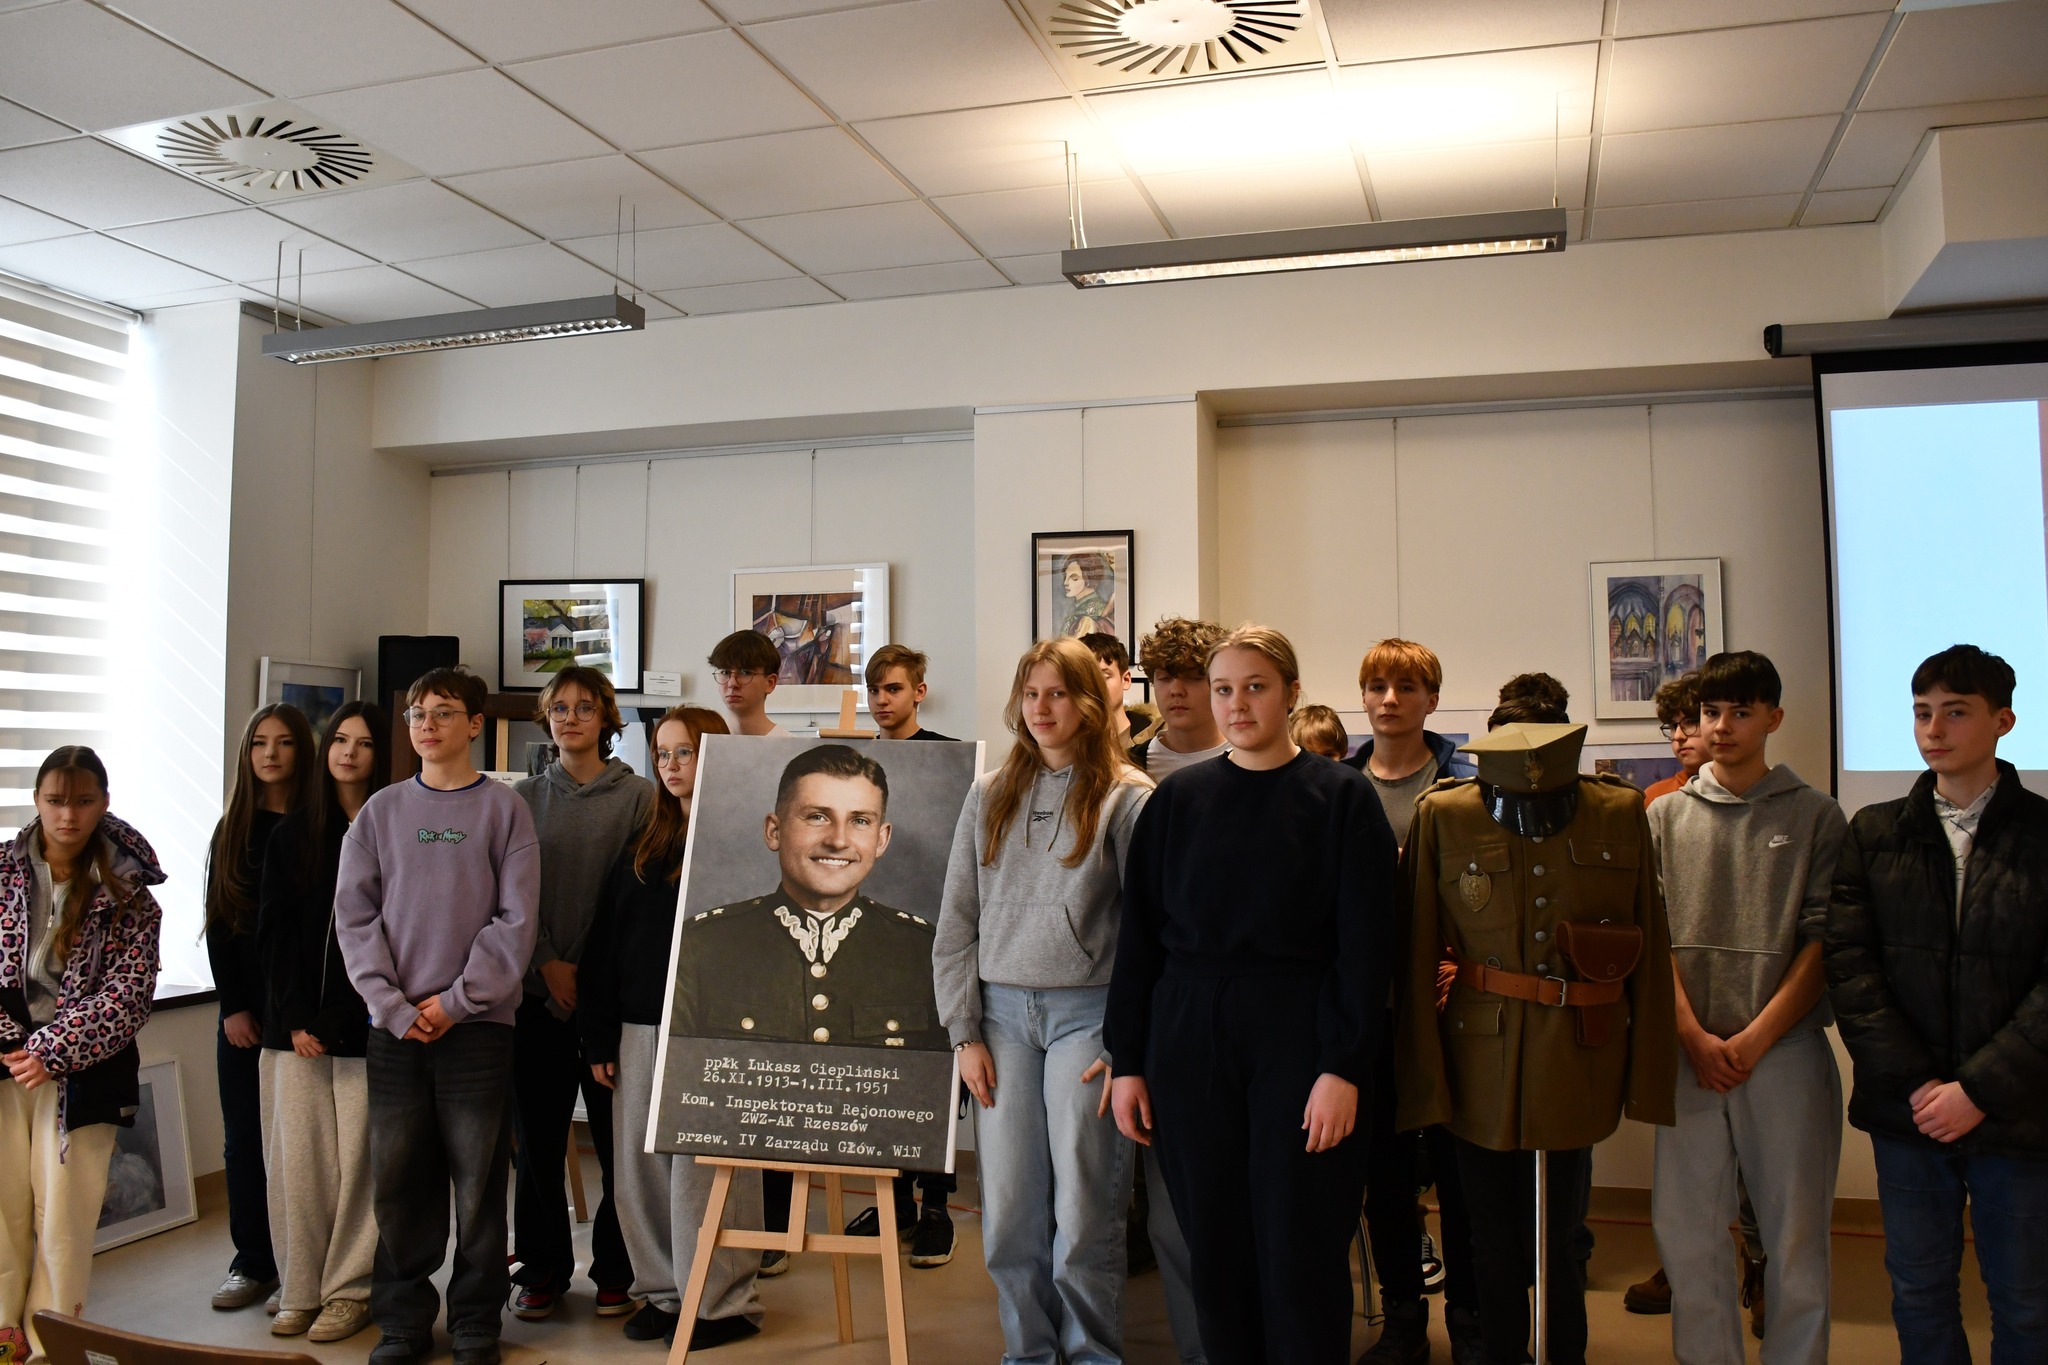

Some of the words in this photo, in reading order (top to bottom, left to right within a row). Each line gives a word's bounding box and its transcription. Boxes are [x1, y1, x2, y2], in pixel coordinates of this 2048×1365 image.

[704, 1057, 739, 1071] ppłk
[747, 1058, 801, 1074] Łukasz
[810, 1063, 900, 1080] Ciepliński
[681, 1092, 715, 1107] Kom.
[725, 1095, 833, 1115] Inspektoratu
[841, 1103, 934, 1123] Rejonowego
[740, 1112, 795, 1128] ZWZ-AK
[803, 1116, 868, 1132] Rzeszów
[675, 1131, 728, 1145] przew.
[738, 1133, 757, 1146] IV
[764, 1135, 829, 1155] Zarządu
[838, 1141, 882, 1156] Głów.
[892, 1145, 922, 1158] WiN
